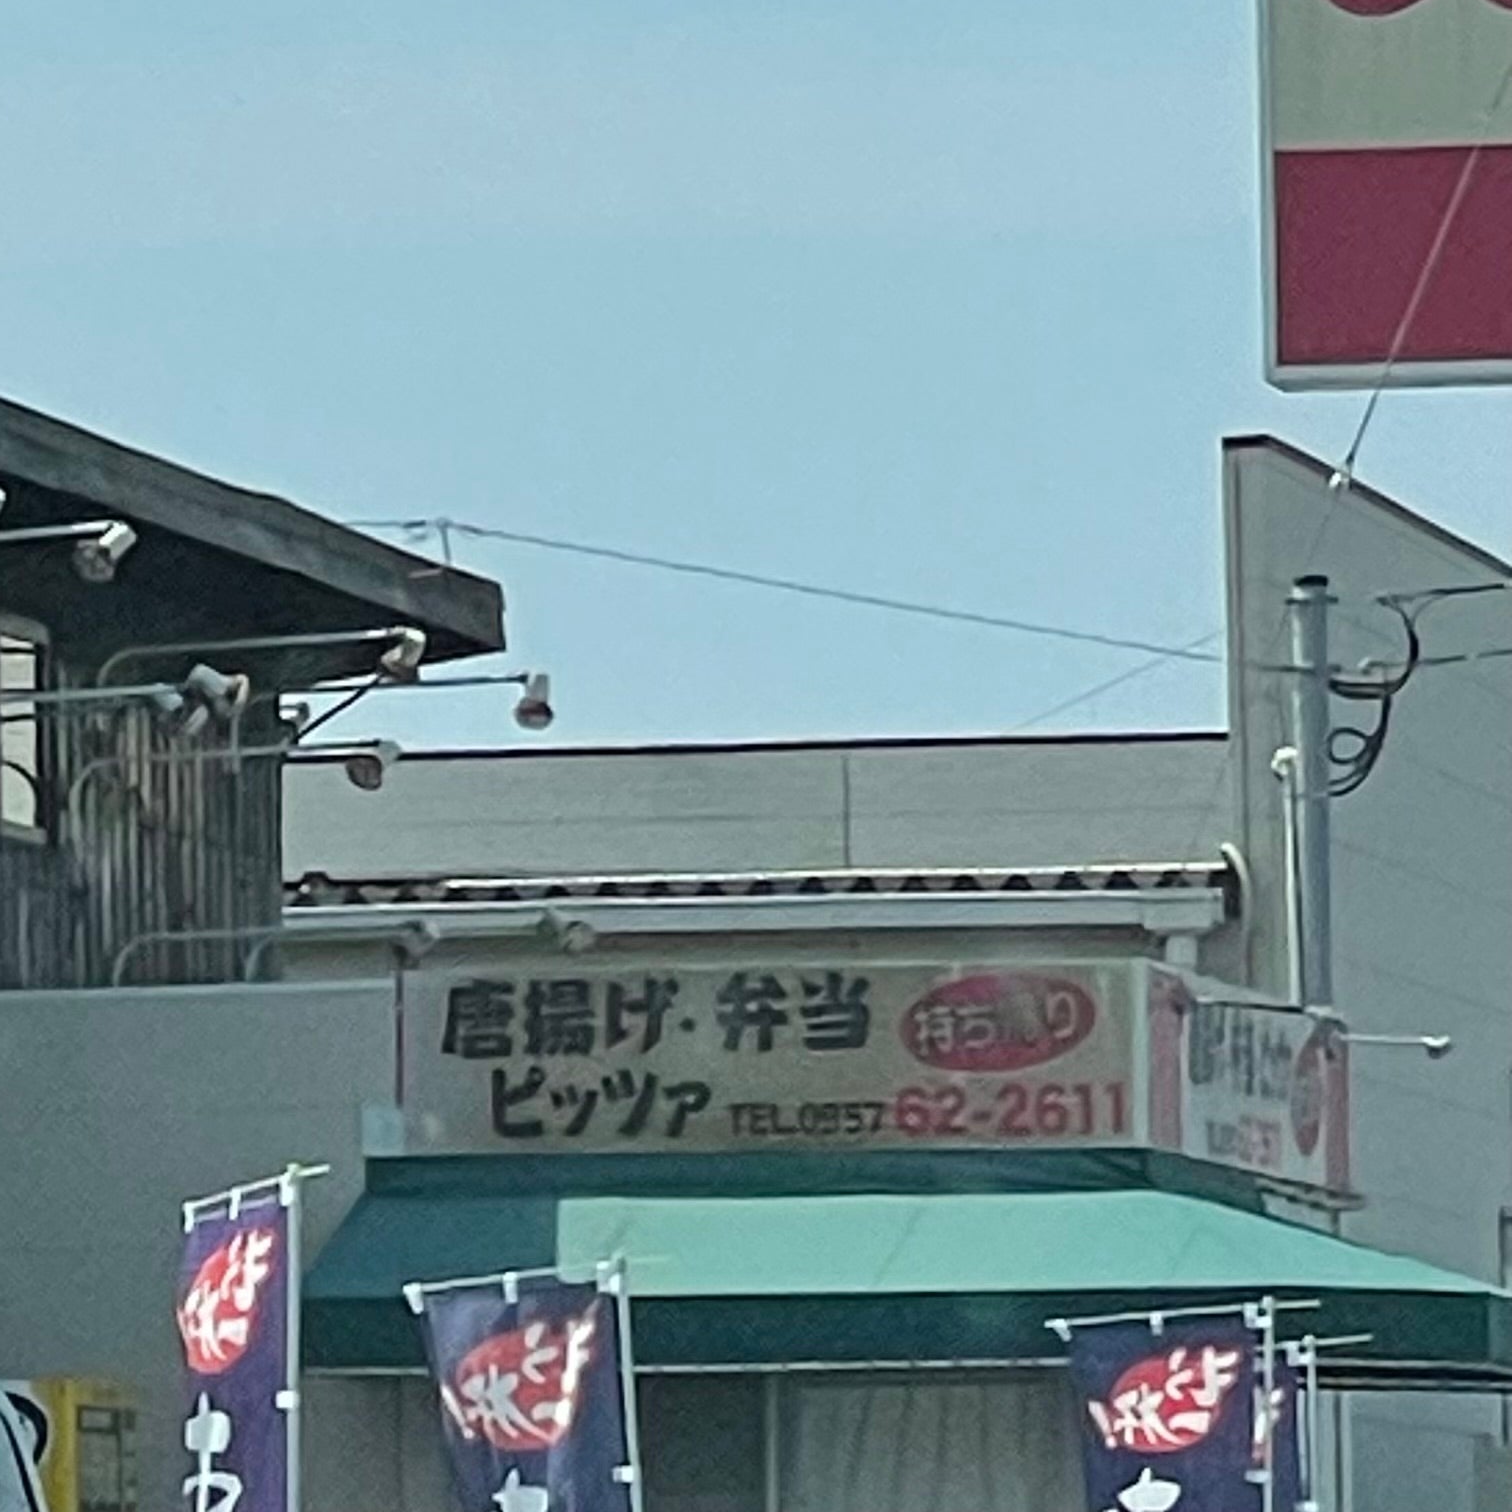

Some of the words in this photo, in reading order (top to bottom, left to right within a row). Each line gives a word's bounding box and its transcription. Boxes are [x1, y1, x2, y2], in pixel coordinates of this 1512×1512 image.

[913, 990, 1077, 1056] 持ちり
[895, 1082, 1126, 1137] 62-2611
